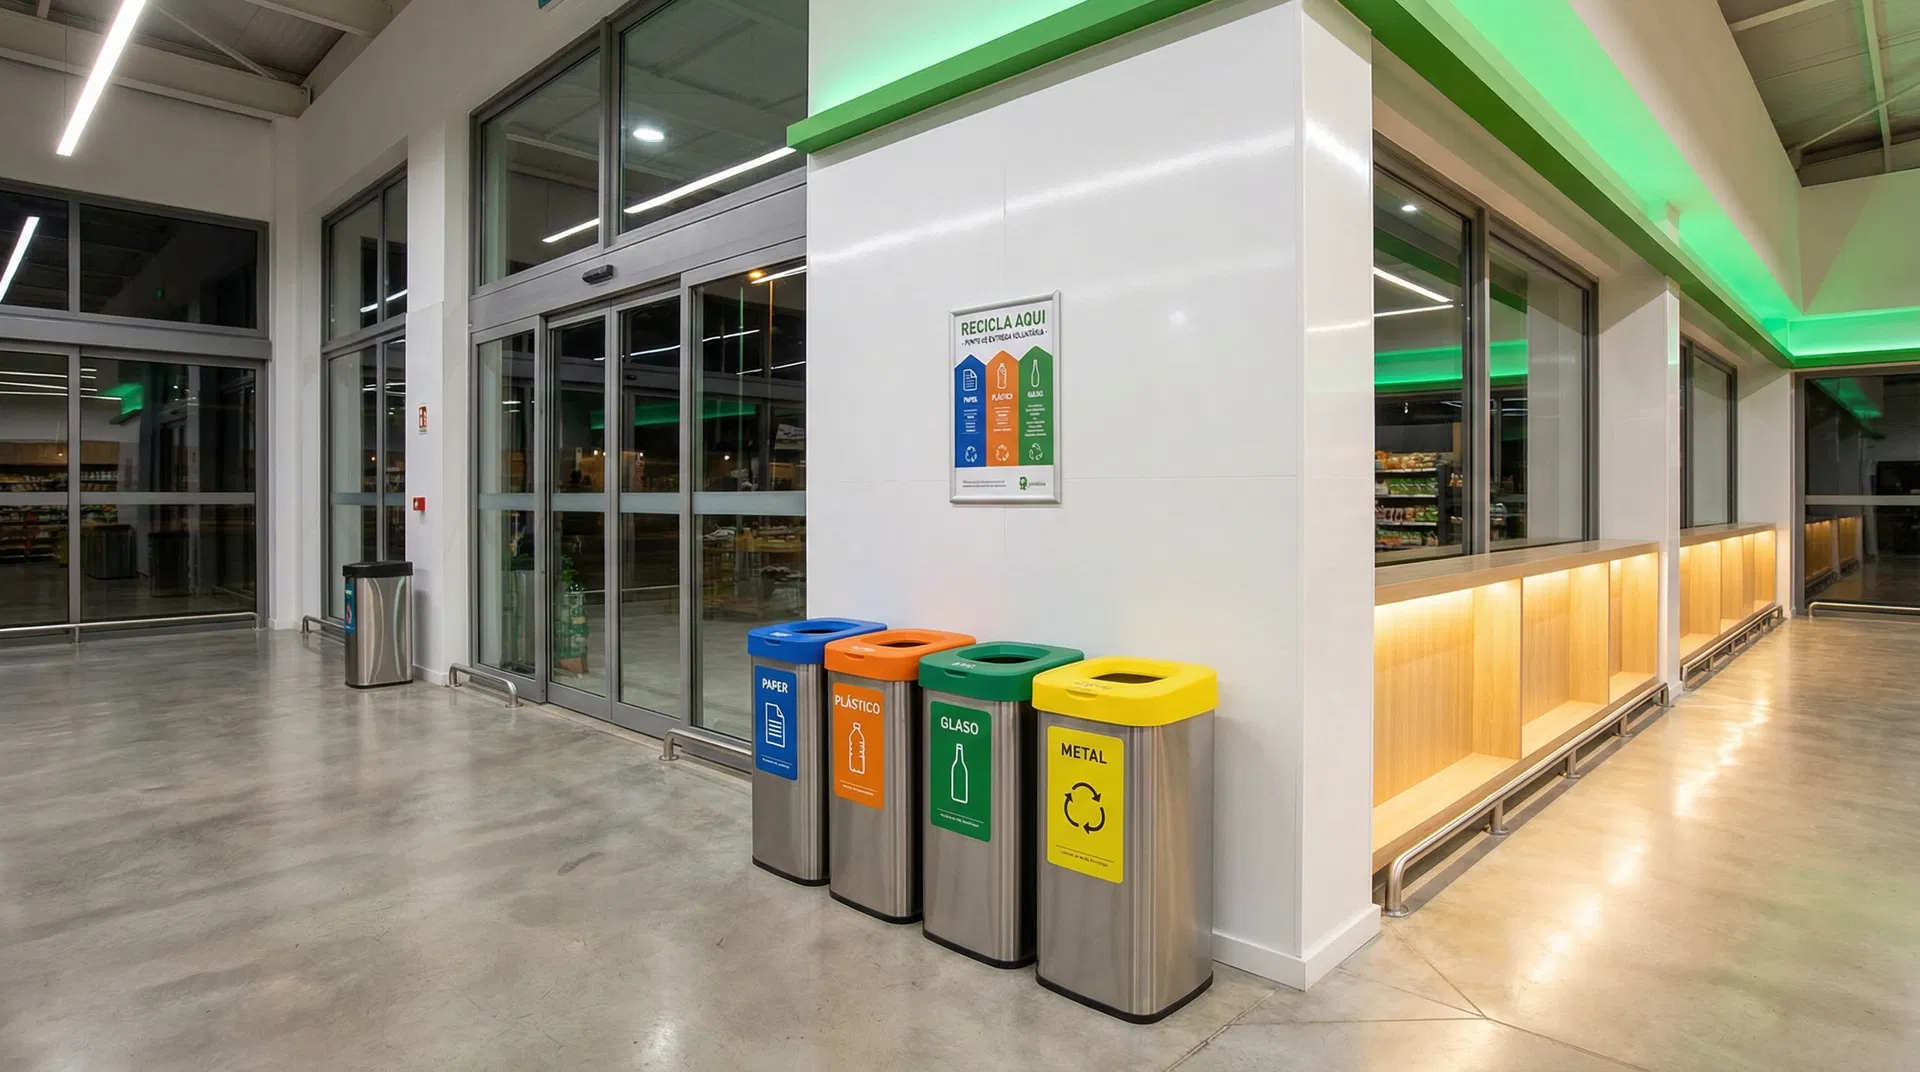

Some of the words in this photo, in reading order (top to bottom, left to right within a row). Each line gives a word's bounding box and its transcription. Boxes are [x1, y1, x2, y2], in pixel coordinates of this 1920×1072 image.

[961, 315, 1012, 336] RECICLA
[1015, 309, 1046, 328] AQUI
[834, 694, 881, 715] PLÁSTICO
[940, 716, 979, 736] GLASO
[1061, 742, 1107, 765] METAL
